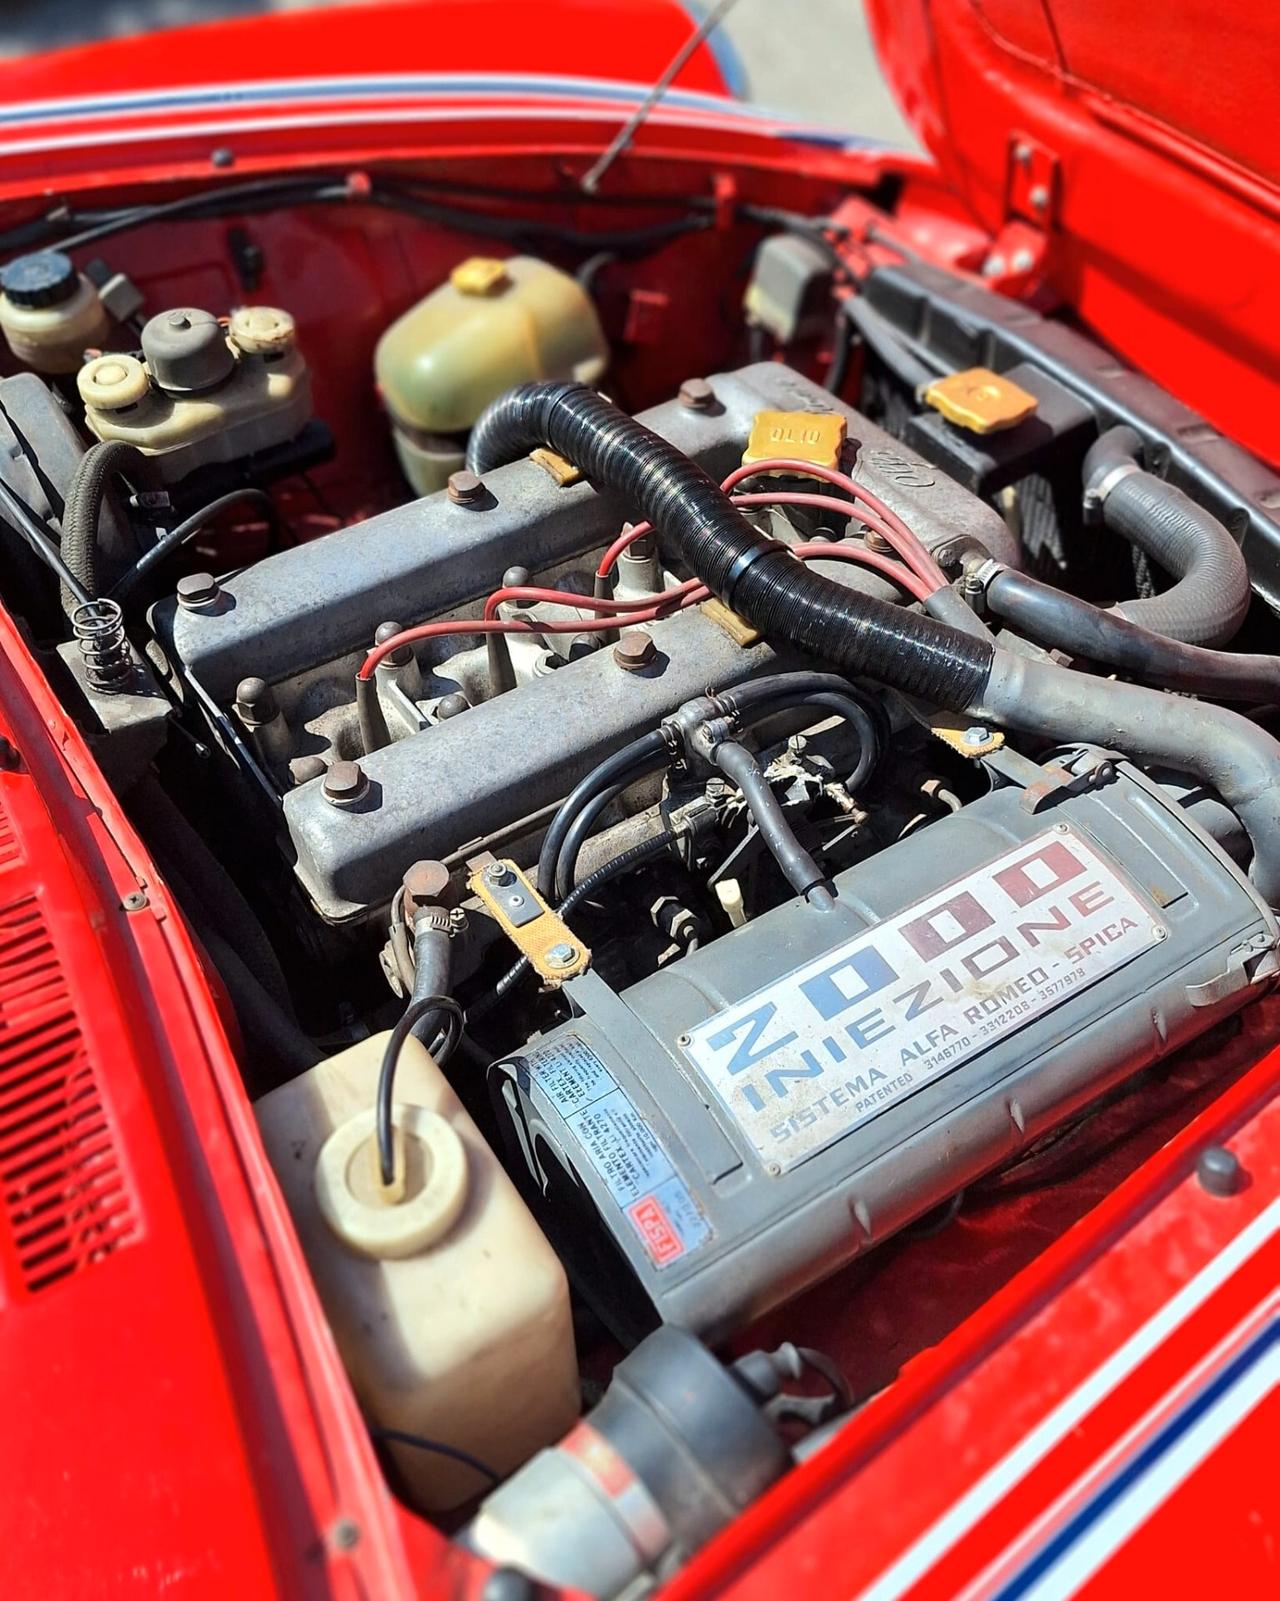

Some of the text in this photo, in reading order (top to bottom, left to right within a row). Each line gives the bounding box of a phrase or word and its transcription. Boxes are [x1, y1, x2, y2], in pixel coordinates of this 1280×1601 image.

[770, 427, 820, 445] OLIO
[740, 881, 1115, 1113] INIEZIONE
[769, 1067, 888, 1144] SISTEMA
[899, 1023, 960, 1067] ALFA
[962, 966, 1049, 1025] ROMEO
[1064, 917, 1139, 965] SPICA
[855, 1072, 914, 1113] PATENTED
[923, 1036, 972, 1071] 3146770
[579, 1108, 611, 1152] FILTRANTE
[592, 1111, 611, 1134] 4270
[576, 1120, 626, 1192] FILTRO ARIA CON
[606, 1150, 640, 1197] ELEMENTO
